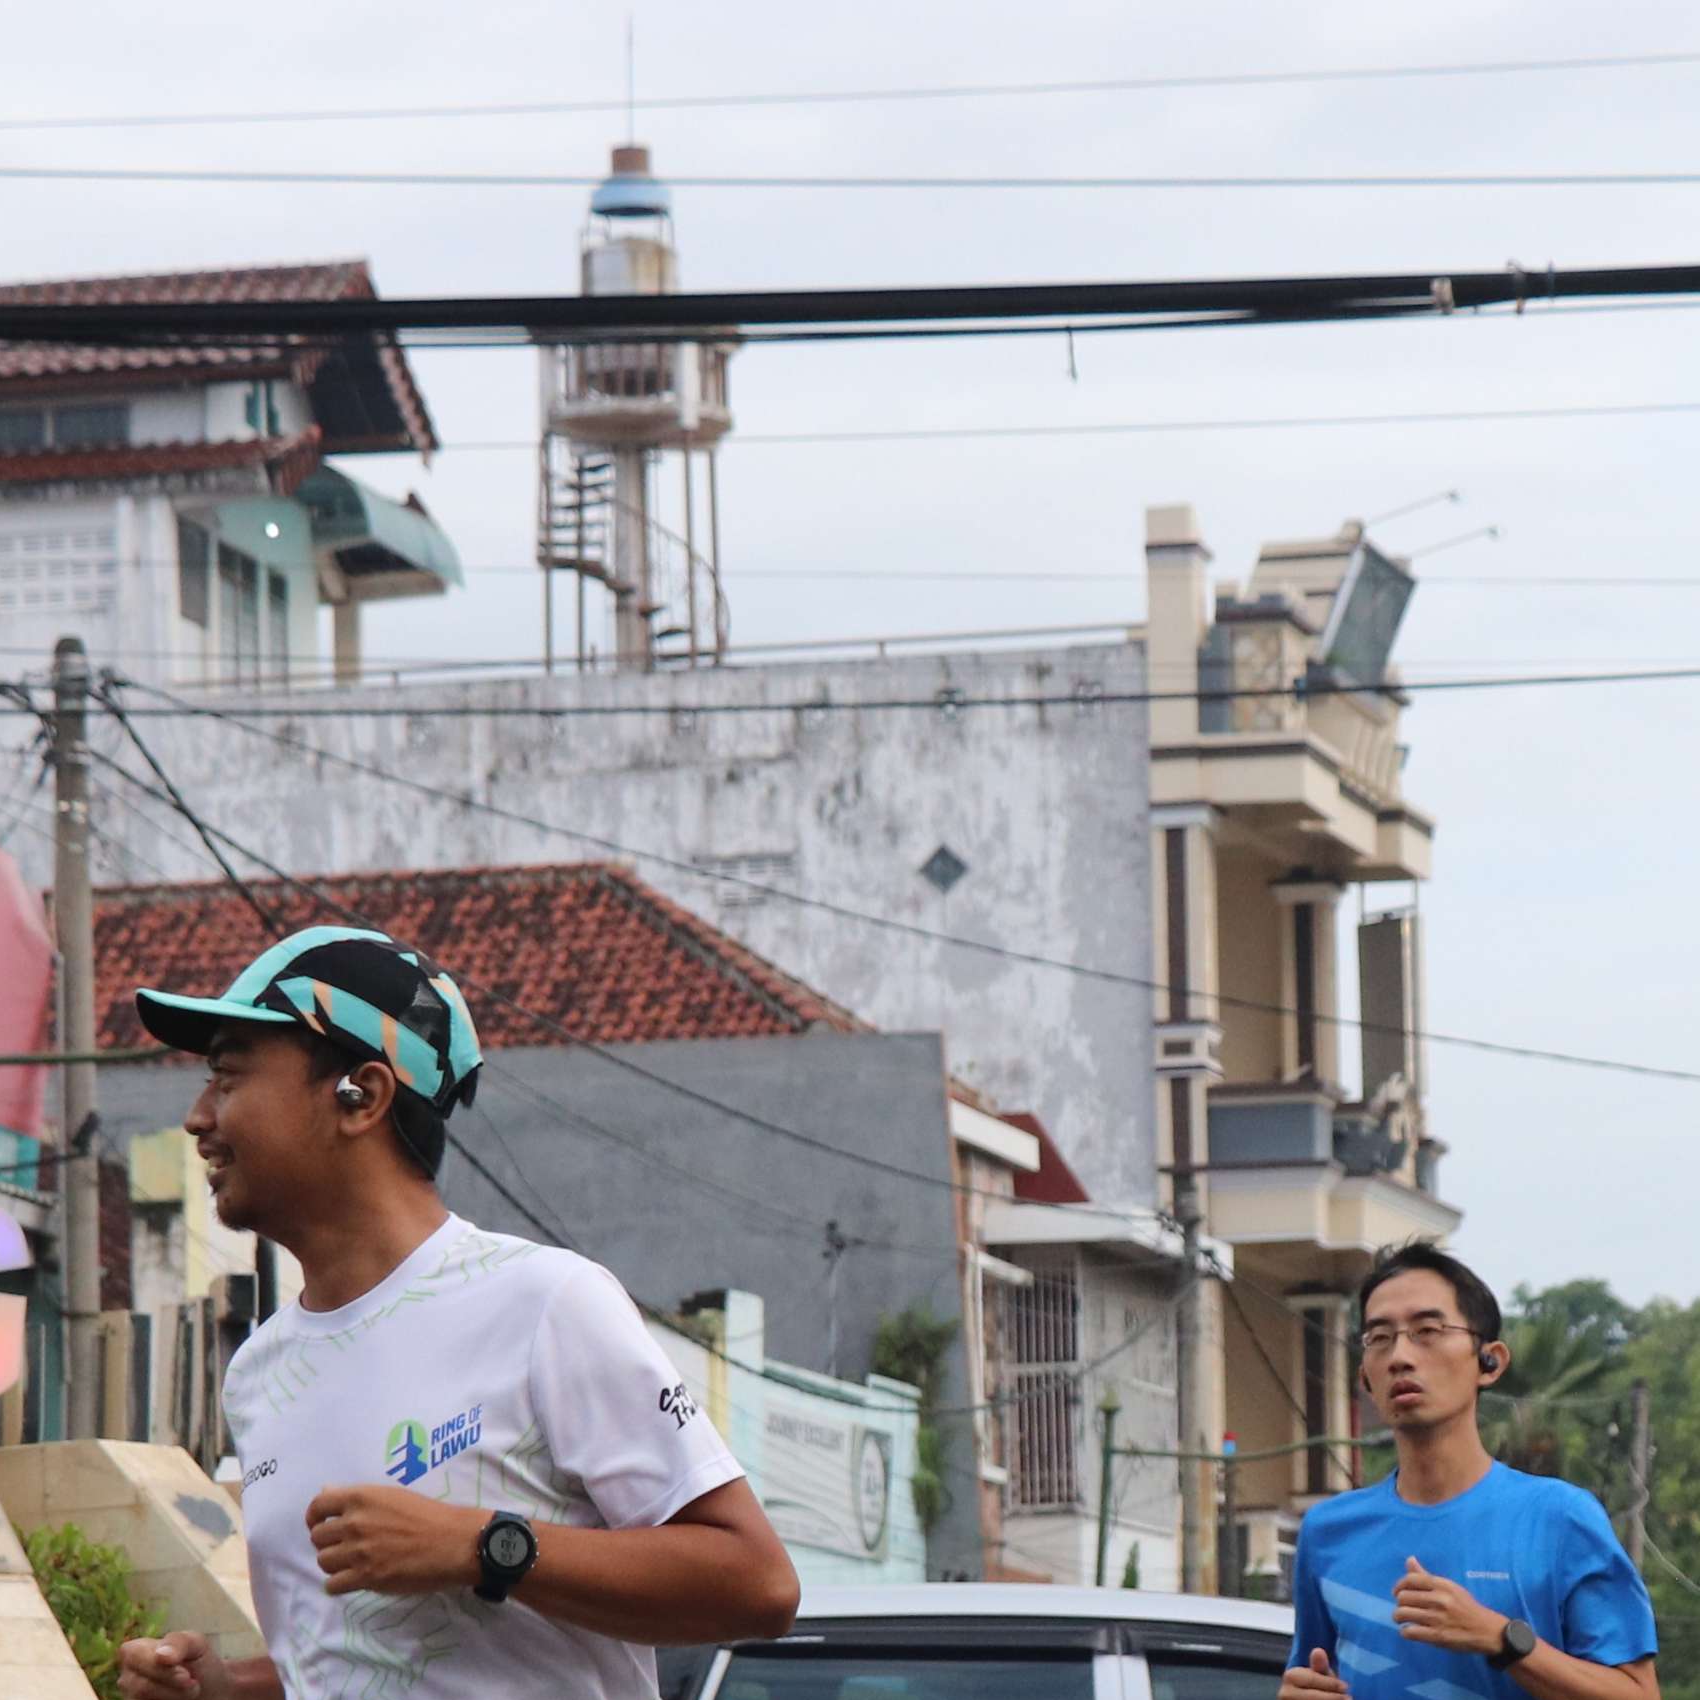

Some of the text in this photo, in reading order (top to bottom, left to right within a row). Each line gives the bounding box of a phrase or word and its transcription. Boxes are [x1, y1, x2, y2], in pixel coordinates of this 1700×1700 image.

[431, 1403, 483, 1446] RING OF
[431, 1423, 482, 1469] LAWU
